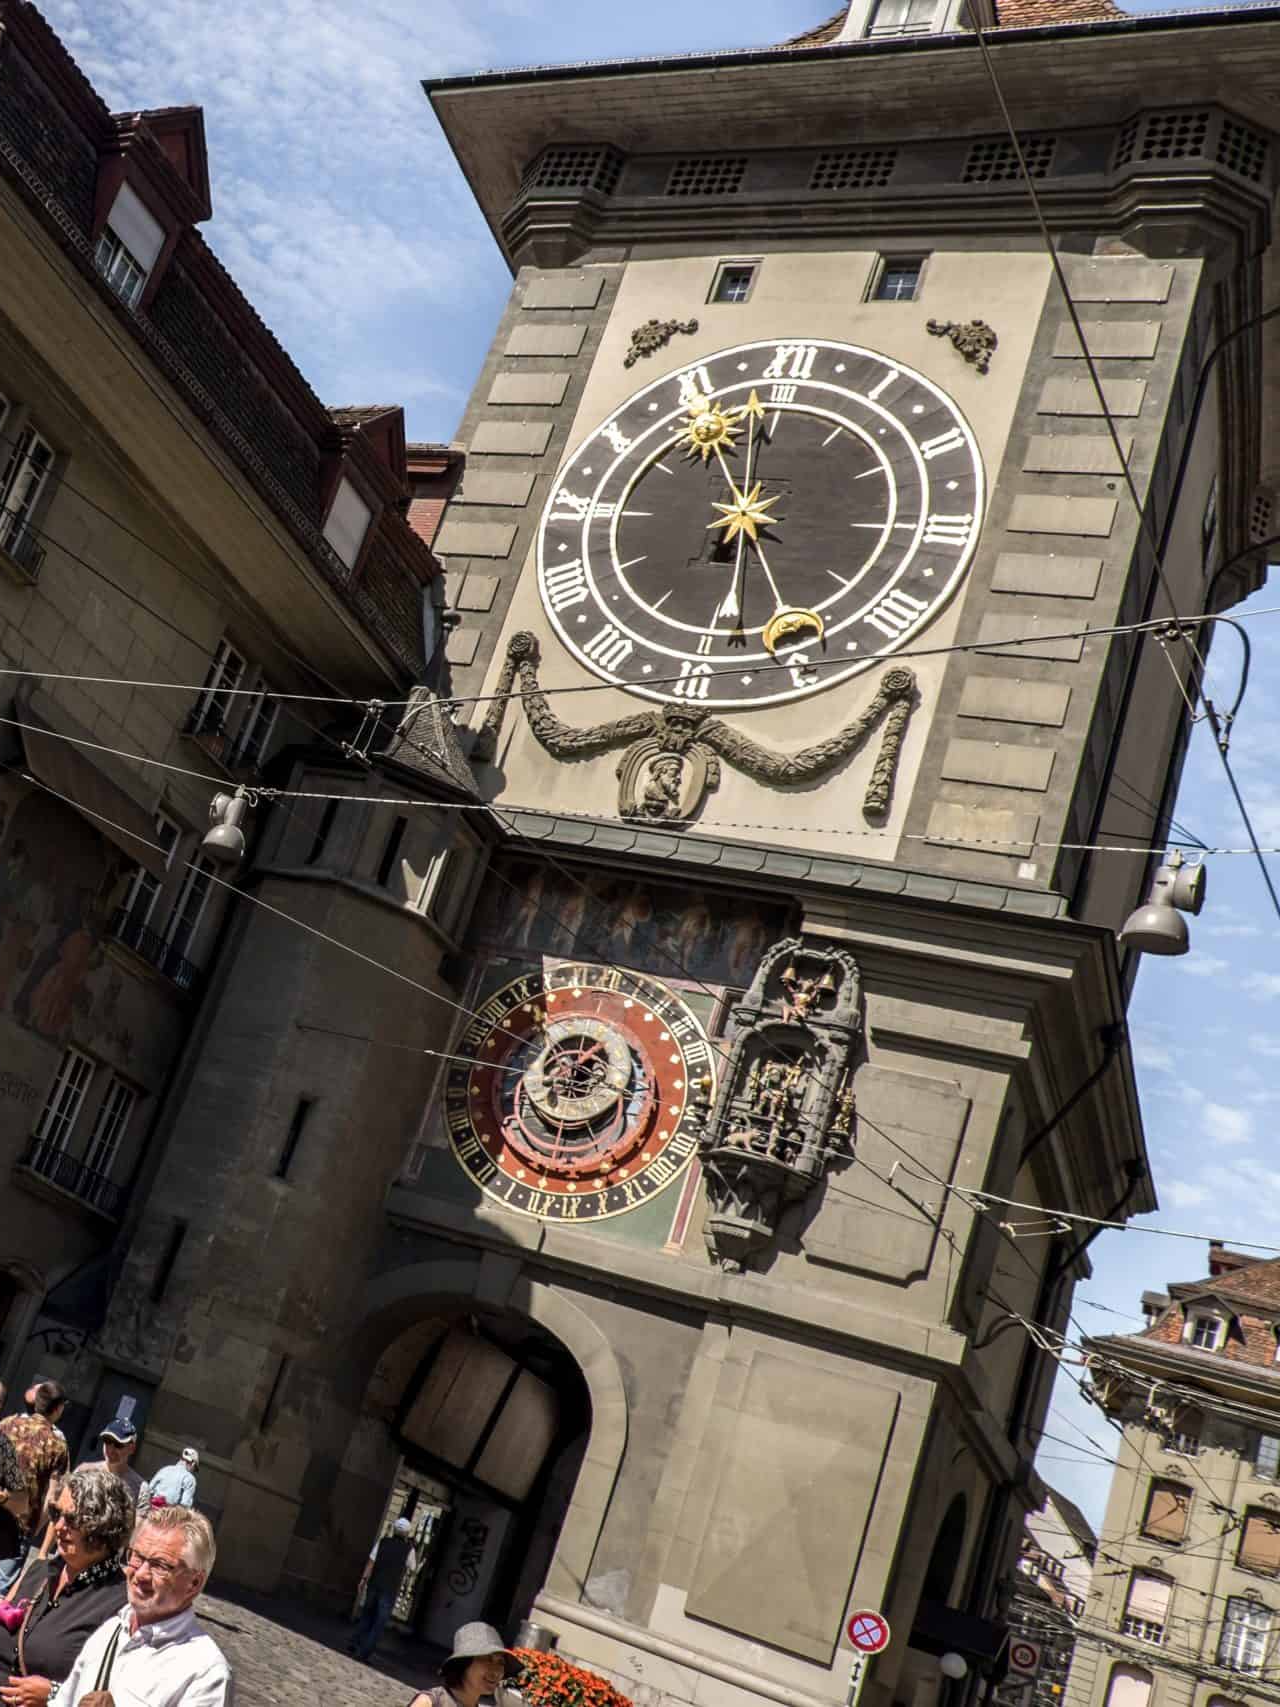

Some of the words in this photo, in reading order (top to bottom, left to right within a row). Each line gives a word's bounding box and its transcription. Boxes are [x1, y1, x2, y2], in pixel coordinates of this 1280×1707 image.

[763, 345, 818, 380] XII
[676, 366, 715, 407] XI
[770, 383, 798, 403] IIII
[868, 369, 900, 401] I
[600, 421, 632, 454] X
[920, 426, 966, 461] II
[549, 487, 592, 522] IX
[922, 513, 974, 547] III
[544, 557, 590, 613] VIII
[863, 589, 929, 639] IIII
[583, 623, 634, 673] VII
[696, 634, 714, 656] II
[673, 660, 714, 699] VI
[509, 979, 531, 1002] IX
[459, 1137, 480, 1161] III
[476, 1161, 497, 1184] II
[503, 1181, 517, 1201] I
[597, 1191, 609, 1216] X
